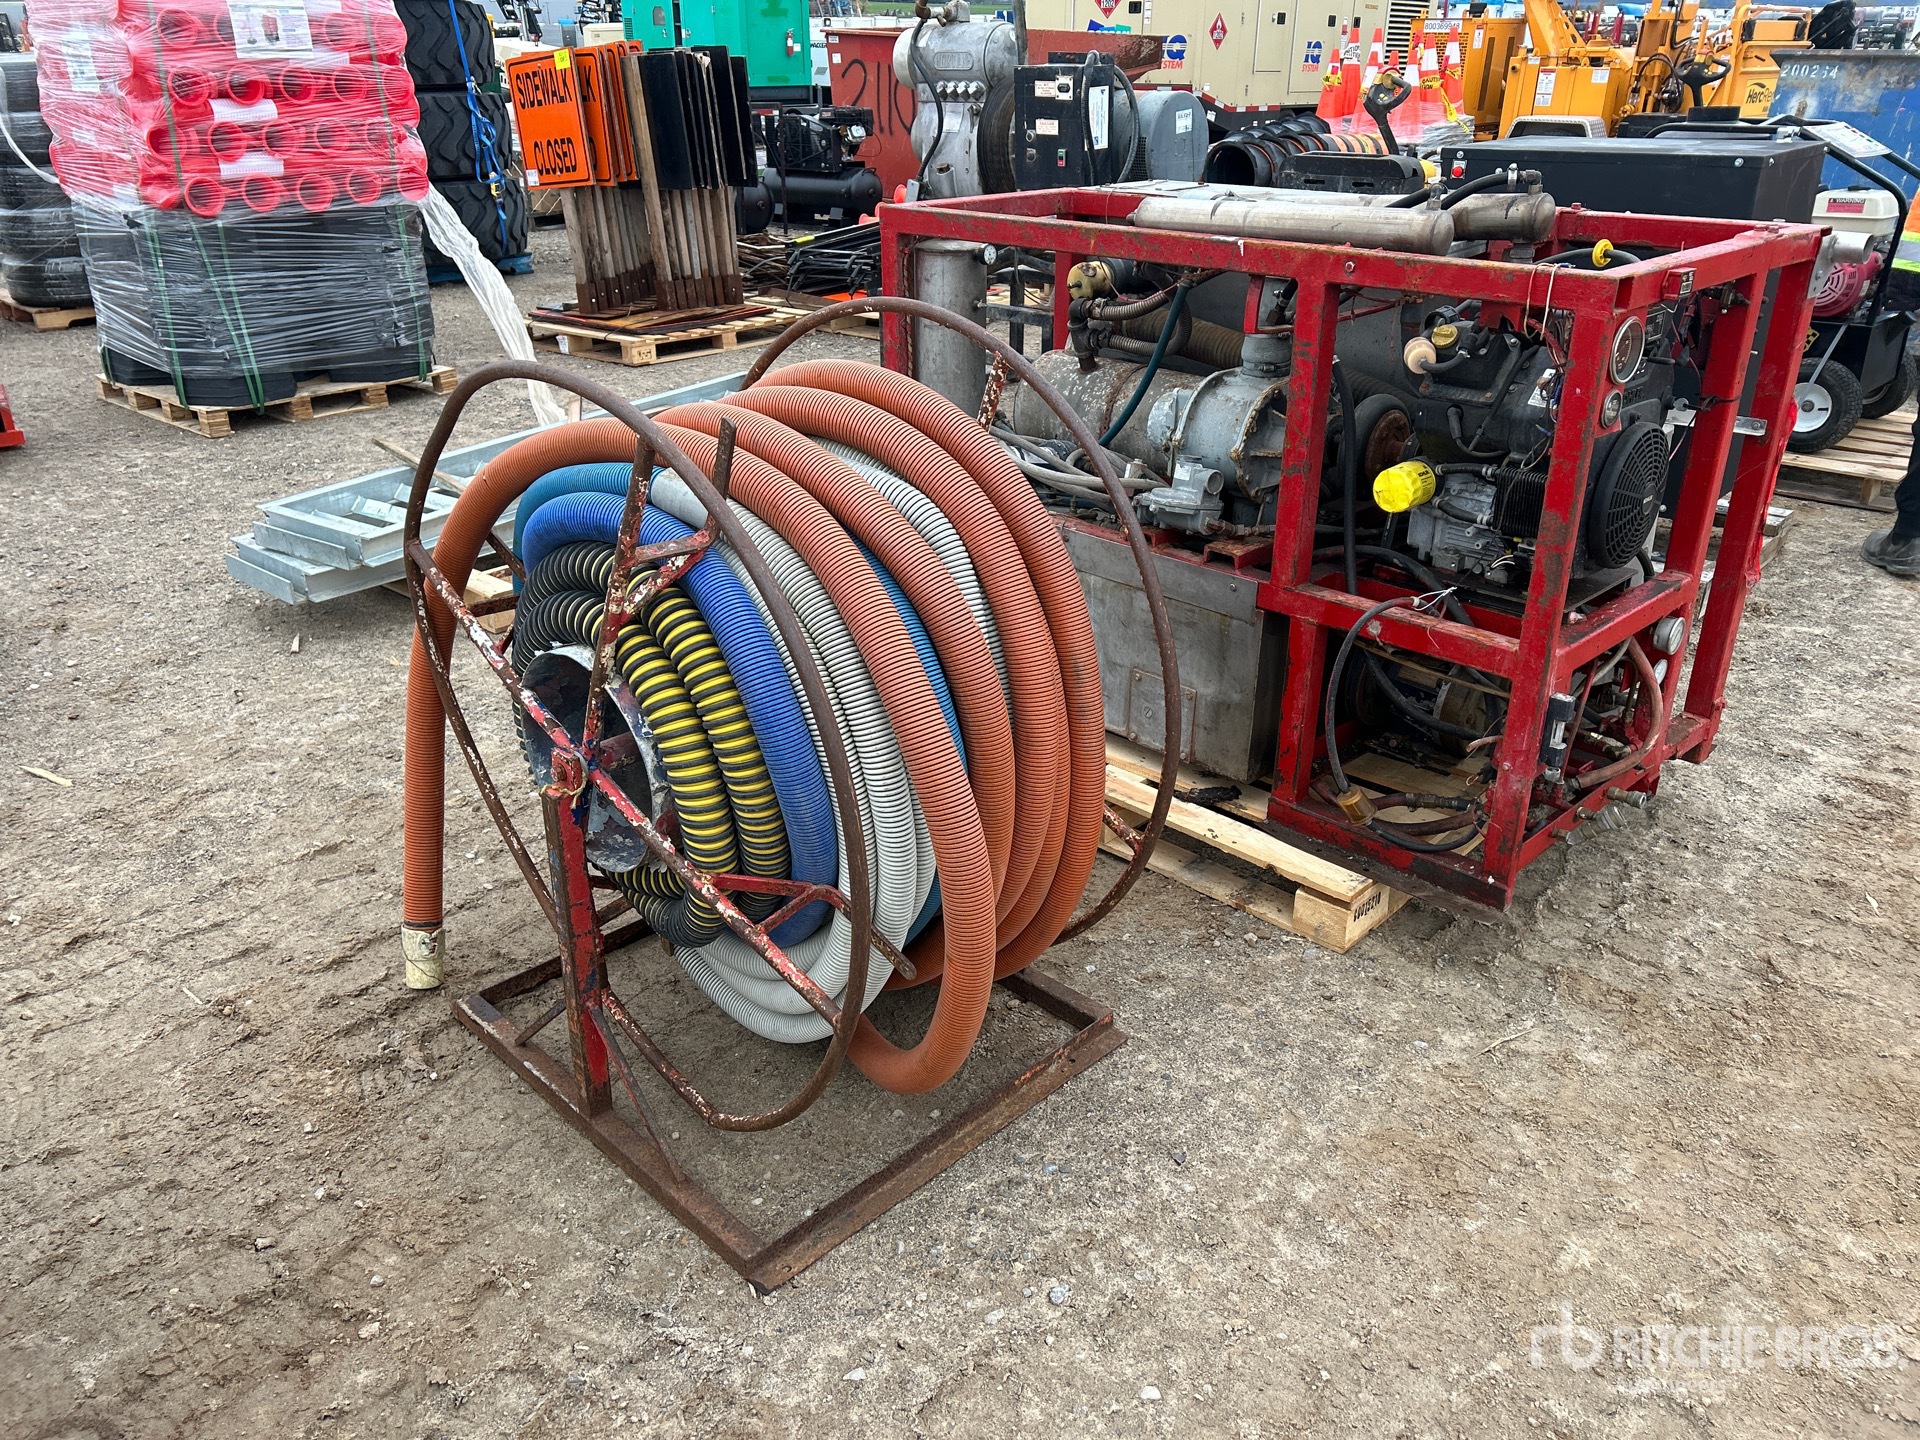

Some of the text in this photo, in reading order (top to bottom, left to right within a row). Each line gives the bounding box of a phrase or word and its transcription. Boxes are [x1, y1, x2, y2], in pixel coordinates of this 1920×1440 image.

[1162, 60, 1183, 69] STEM
[1303, 40, 1323, 65] IQ
[1301, 63, 1319, 73] SYSTEM
[515, 65, 572, 110] SIDEWALK
[533, 136, 577, 176] CLOSED
